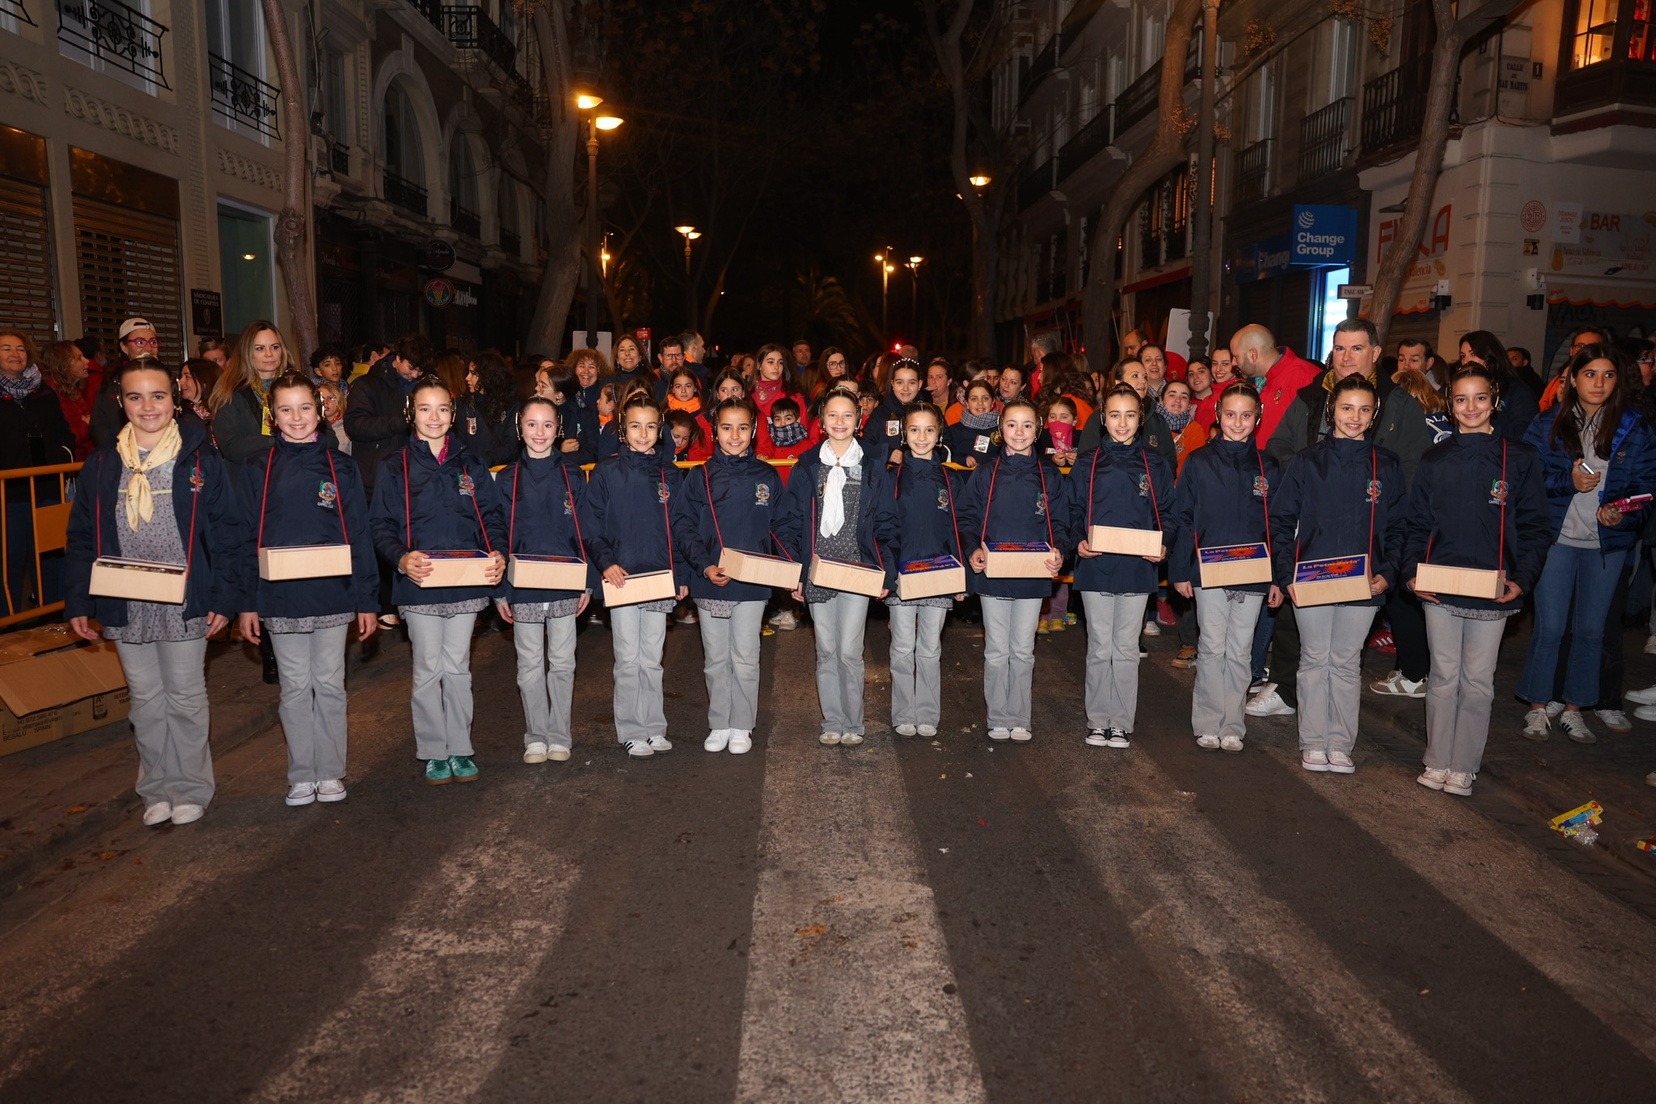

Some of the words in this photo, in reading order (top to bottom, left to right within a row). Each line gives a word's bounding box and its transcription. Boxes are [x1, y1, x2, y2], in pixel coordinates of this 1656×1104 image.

[1507, 63, 1523, 71] CALLE
[1590, 213, 1620, 232] BAR
[1297, 232, 1344, 246] Change
[1296, 244, 1335, 258] Group
[1258, 250, 1290, 271] Chang
